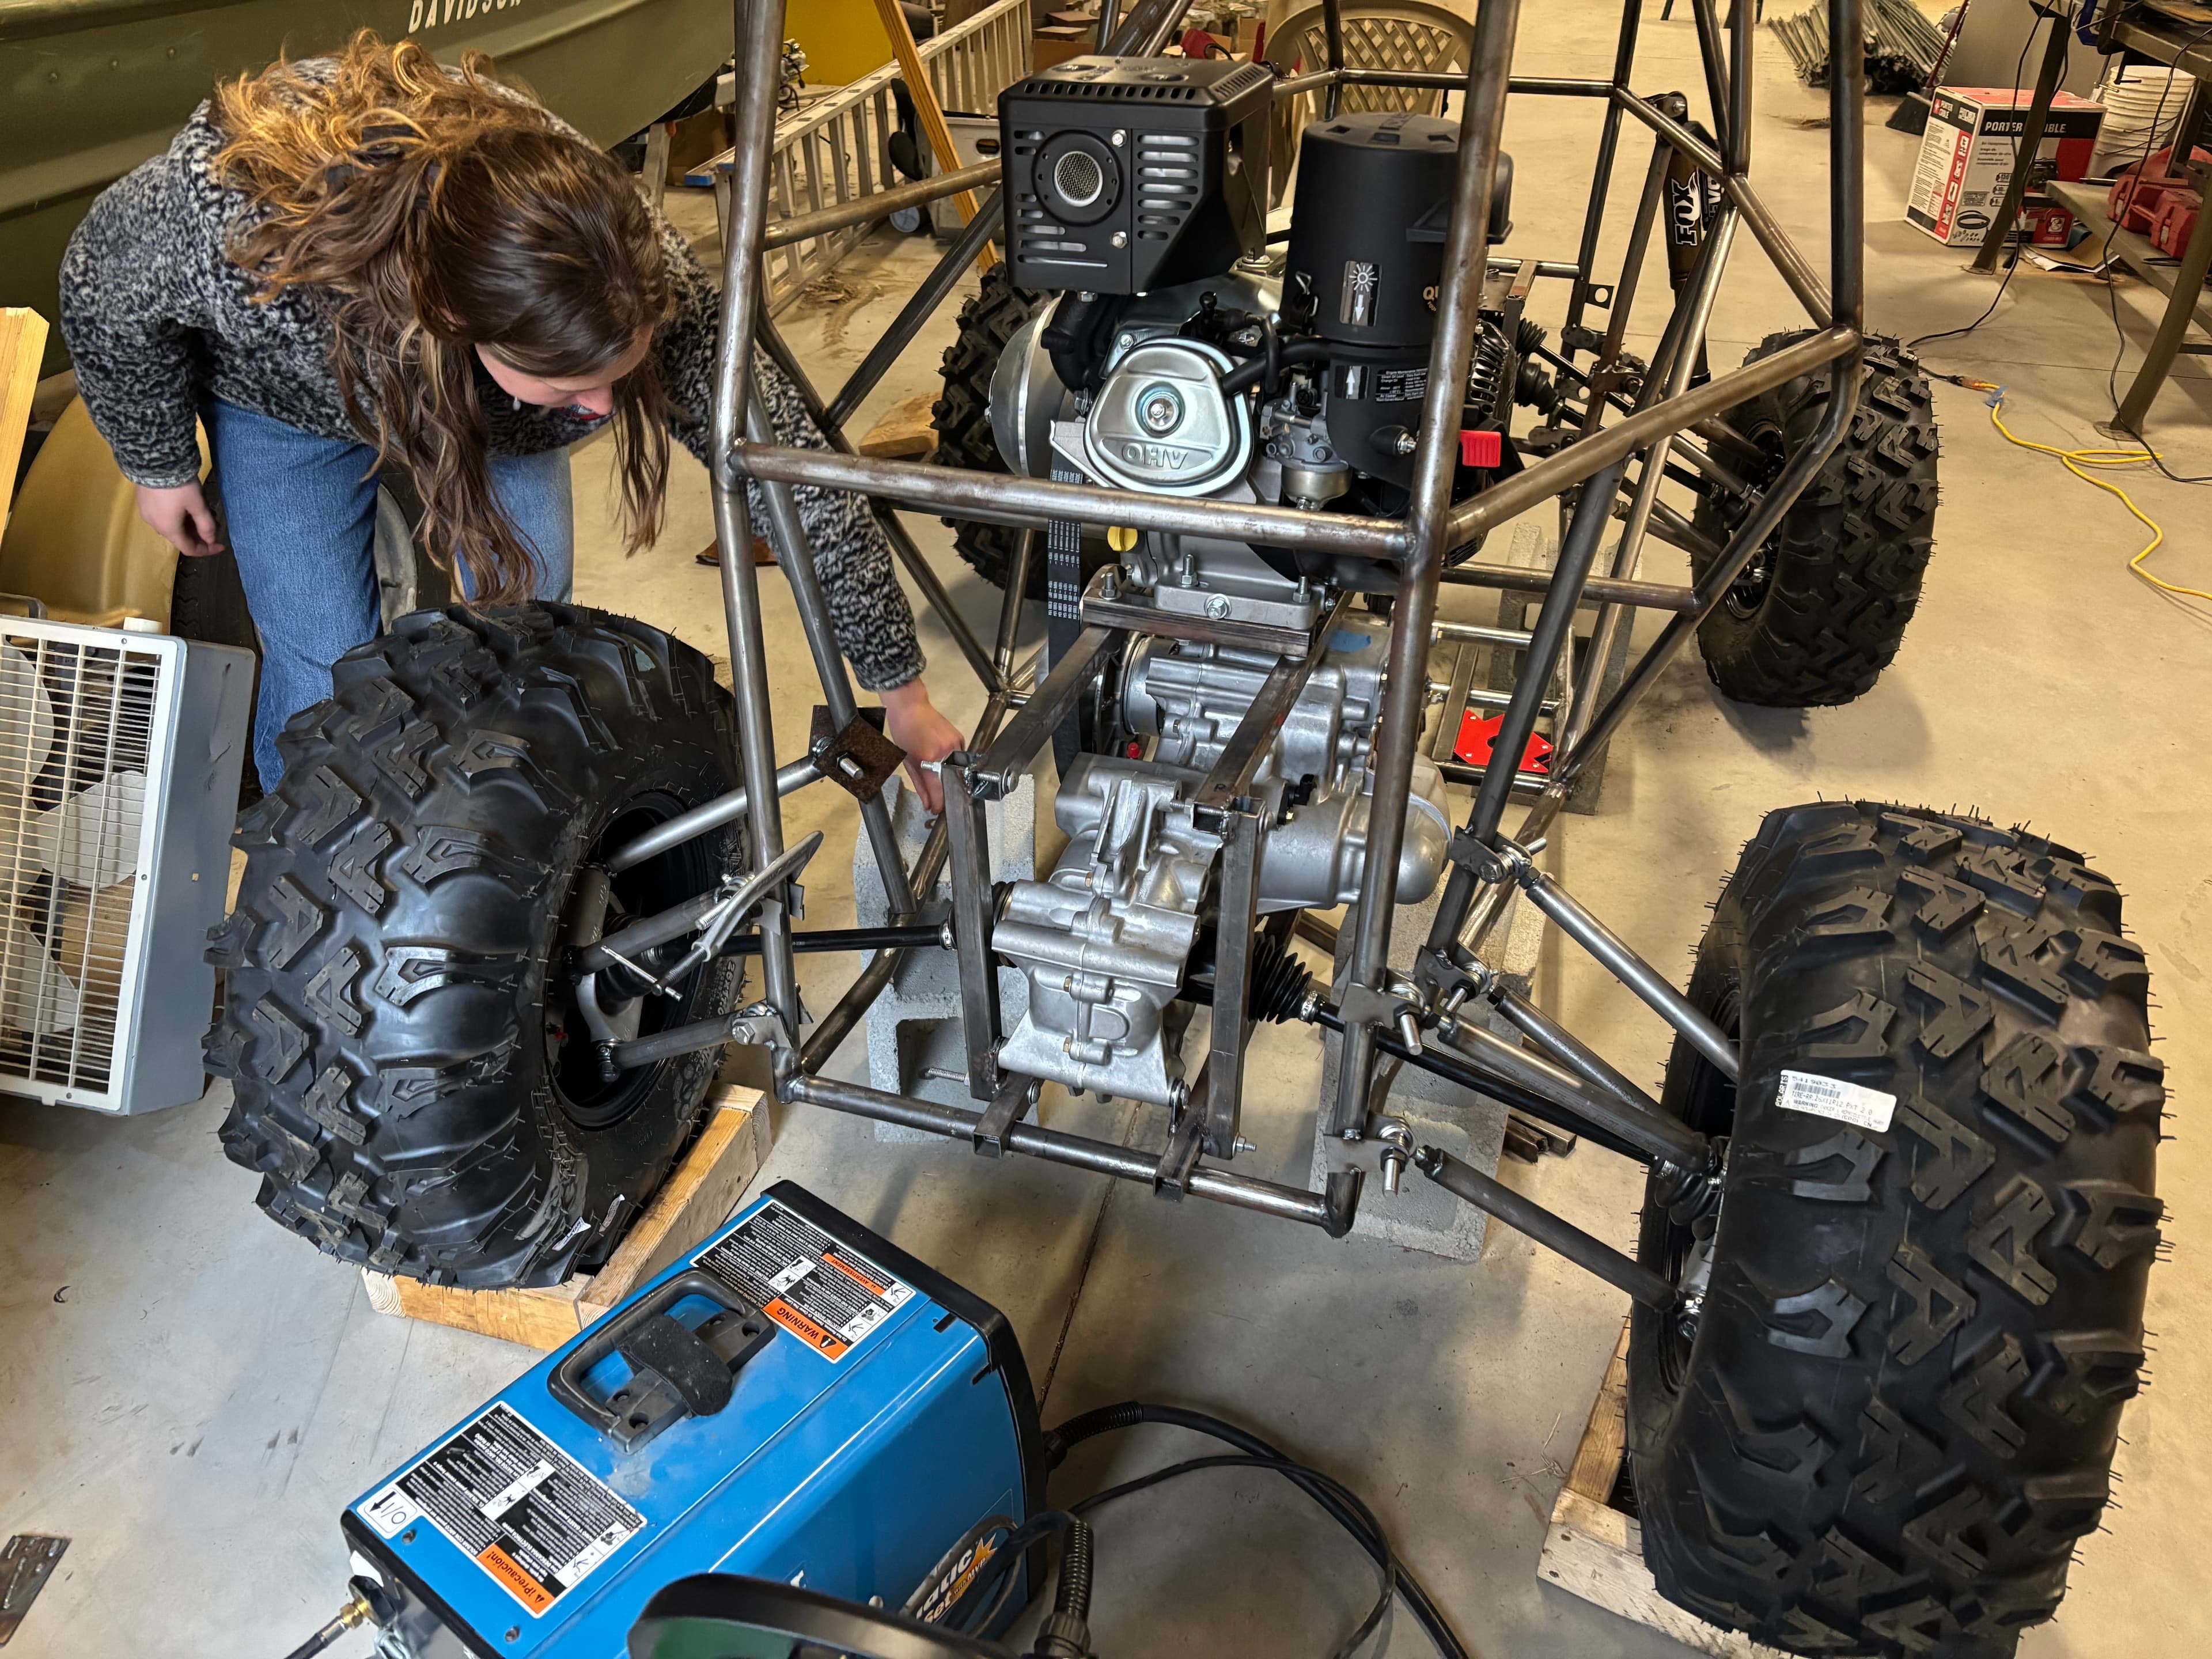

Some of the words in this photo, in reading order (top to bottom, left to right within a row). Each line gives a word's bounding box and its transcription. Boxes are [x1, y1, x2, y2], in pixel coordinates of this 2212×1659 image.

[408, 0, 521, 34] DAVID
[1671, 175, 1700, 245] FOX
[1122, 442, 1189, 469] OHV
[1775, 1075, 1789, 1107] POLARIS
[830, 1258, 869, 1285] AVERTISSEMENT
[776, 1306, 820, 1339] WARNING
